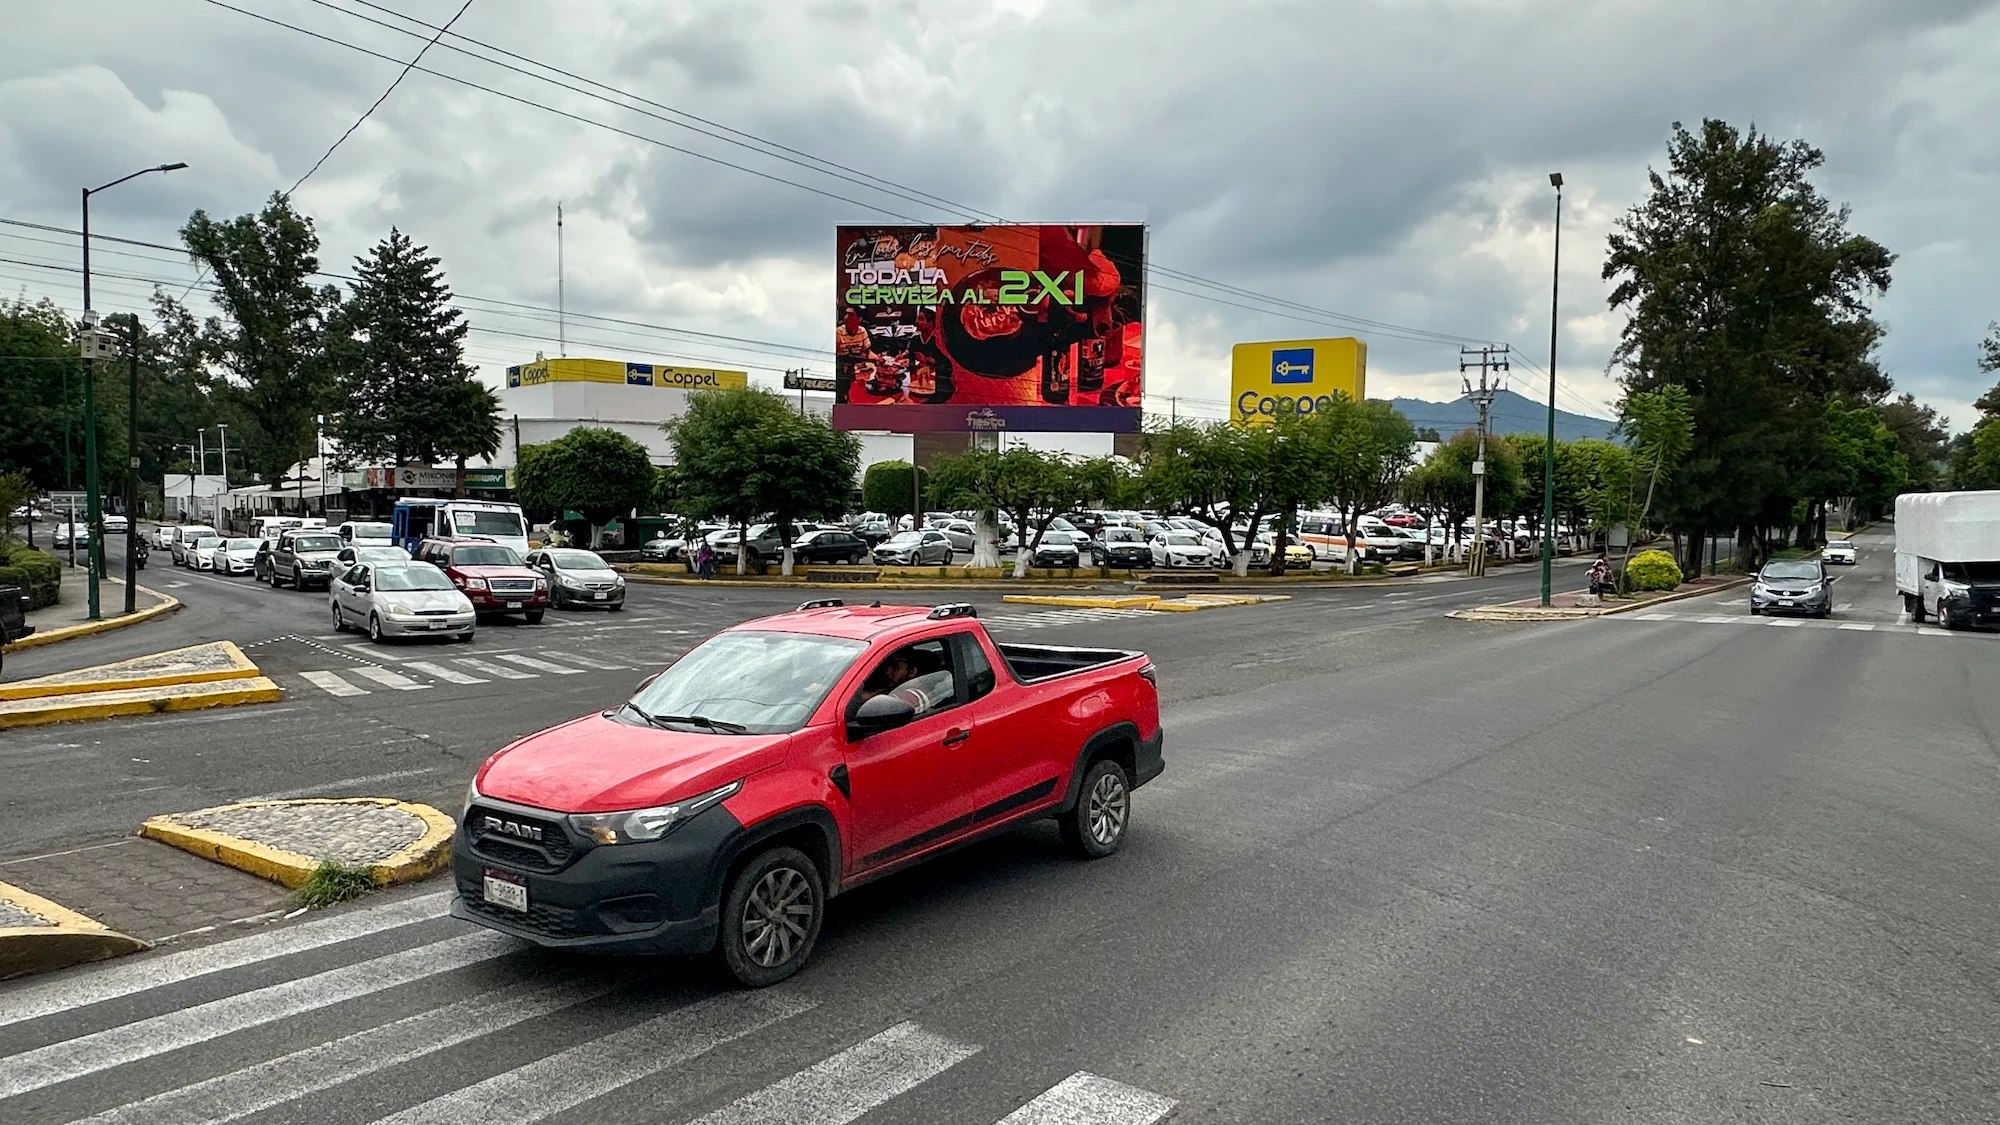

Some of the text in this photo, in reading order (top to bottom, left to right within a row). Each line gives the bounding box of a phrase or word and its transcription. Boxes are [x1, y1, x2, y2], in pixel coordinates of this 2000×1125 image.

[934, 240, 999, 265] partidos
[845, 268, 948, 285] TODA LA
[845, 269, 1084, 305] CERVEZA AL 2X1
[523, 362, 550, 384] Coppel
[663, 368, 720, 388] Coppel
[966, 410, 1006, 428] fiesta
[464, 474, 503, 482] SUBWAY
[484, 815, 541, 840] RAM
